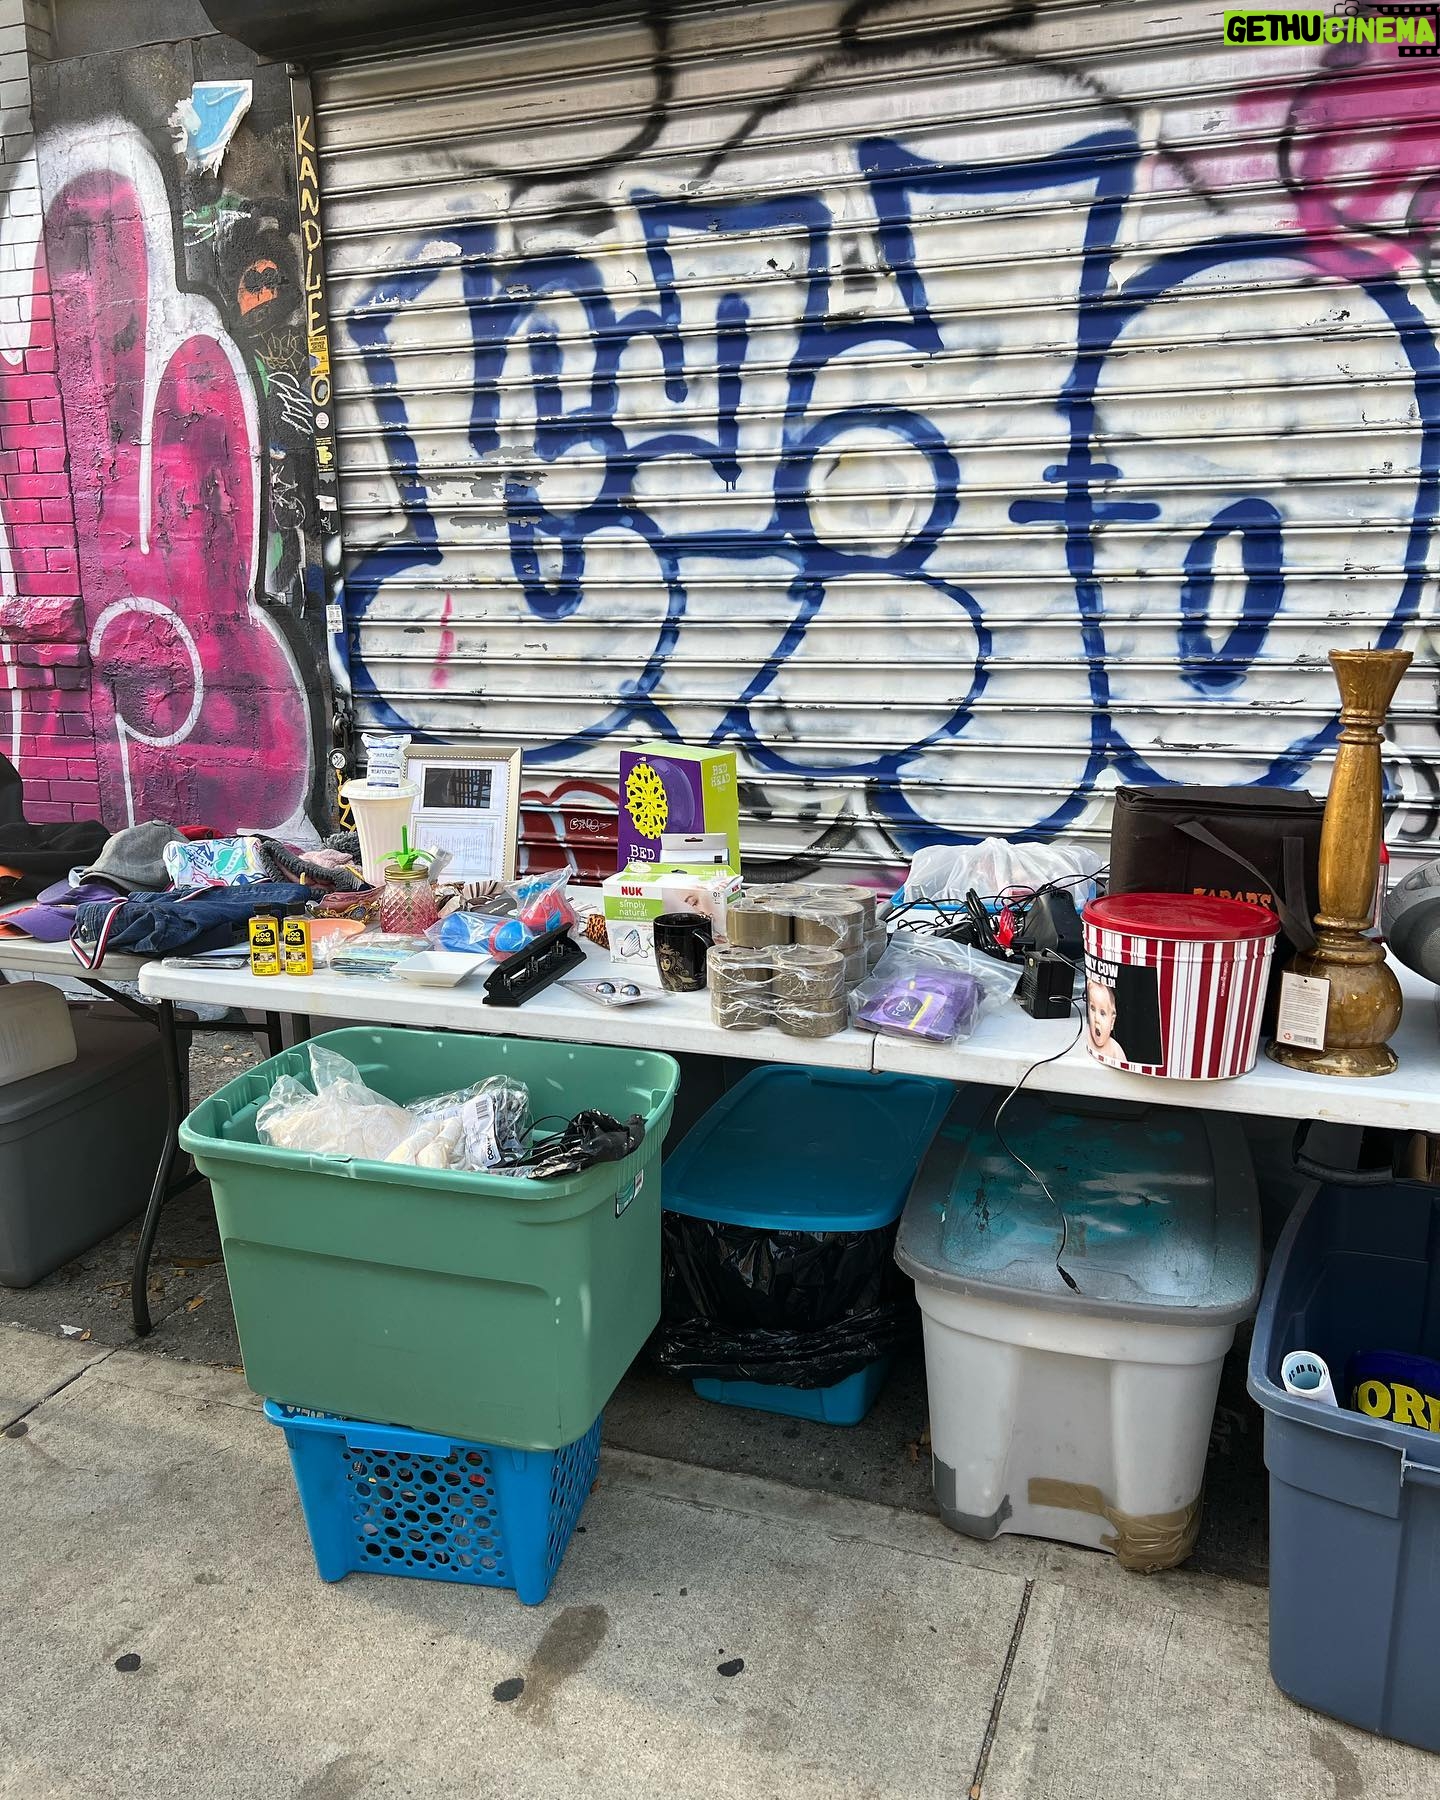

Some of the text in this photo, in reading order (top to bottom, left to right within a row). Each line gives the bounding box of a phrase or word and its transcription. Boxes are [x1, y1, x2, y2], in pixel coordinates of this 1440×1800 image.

[712, 763, 728, 776] BED
[710, 774, 731, 787] HEAD
[629, 844, 656, 860] BED
[621, 886, 643, 896] NUK
[619, 899, 646, 910] simply
[619, 908, 647, 917] natural
[1098, 960, 1119, 978] COW
[1352, 1380, 1440, 1433] OR
